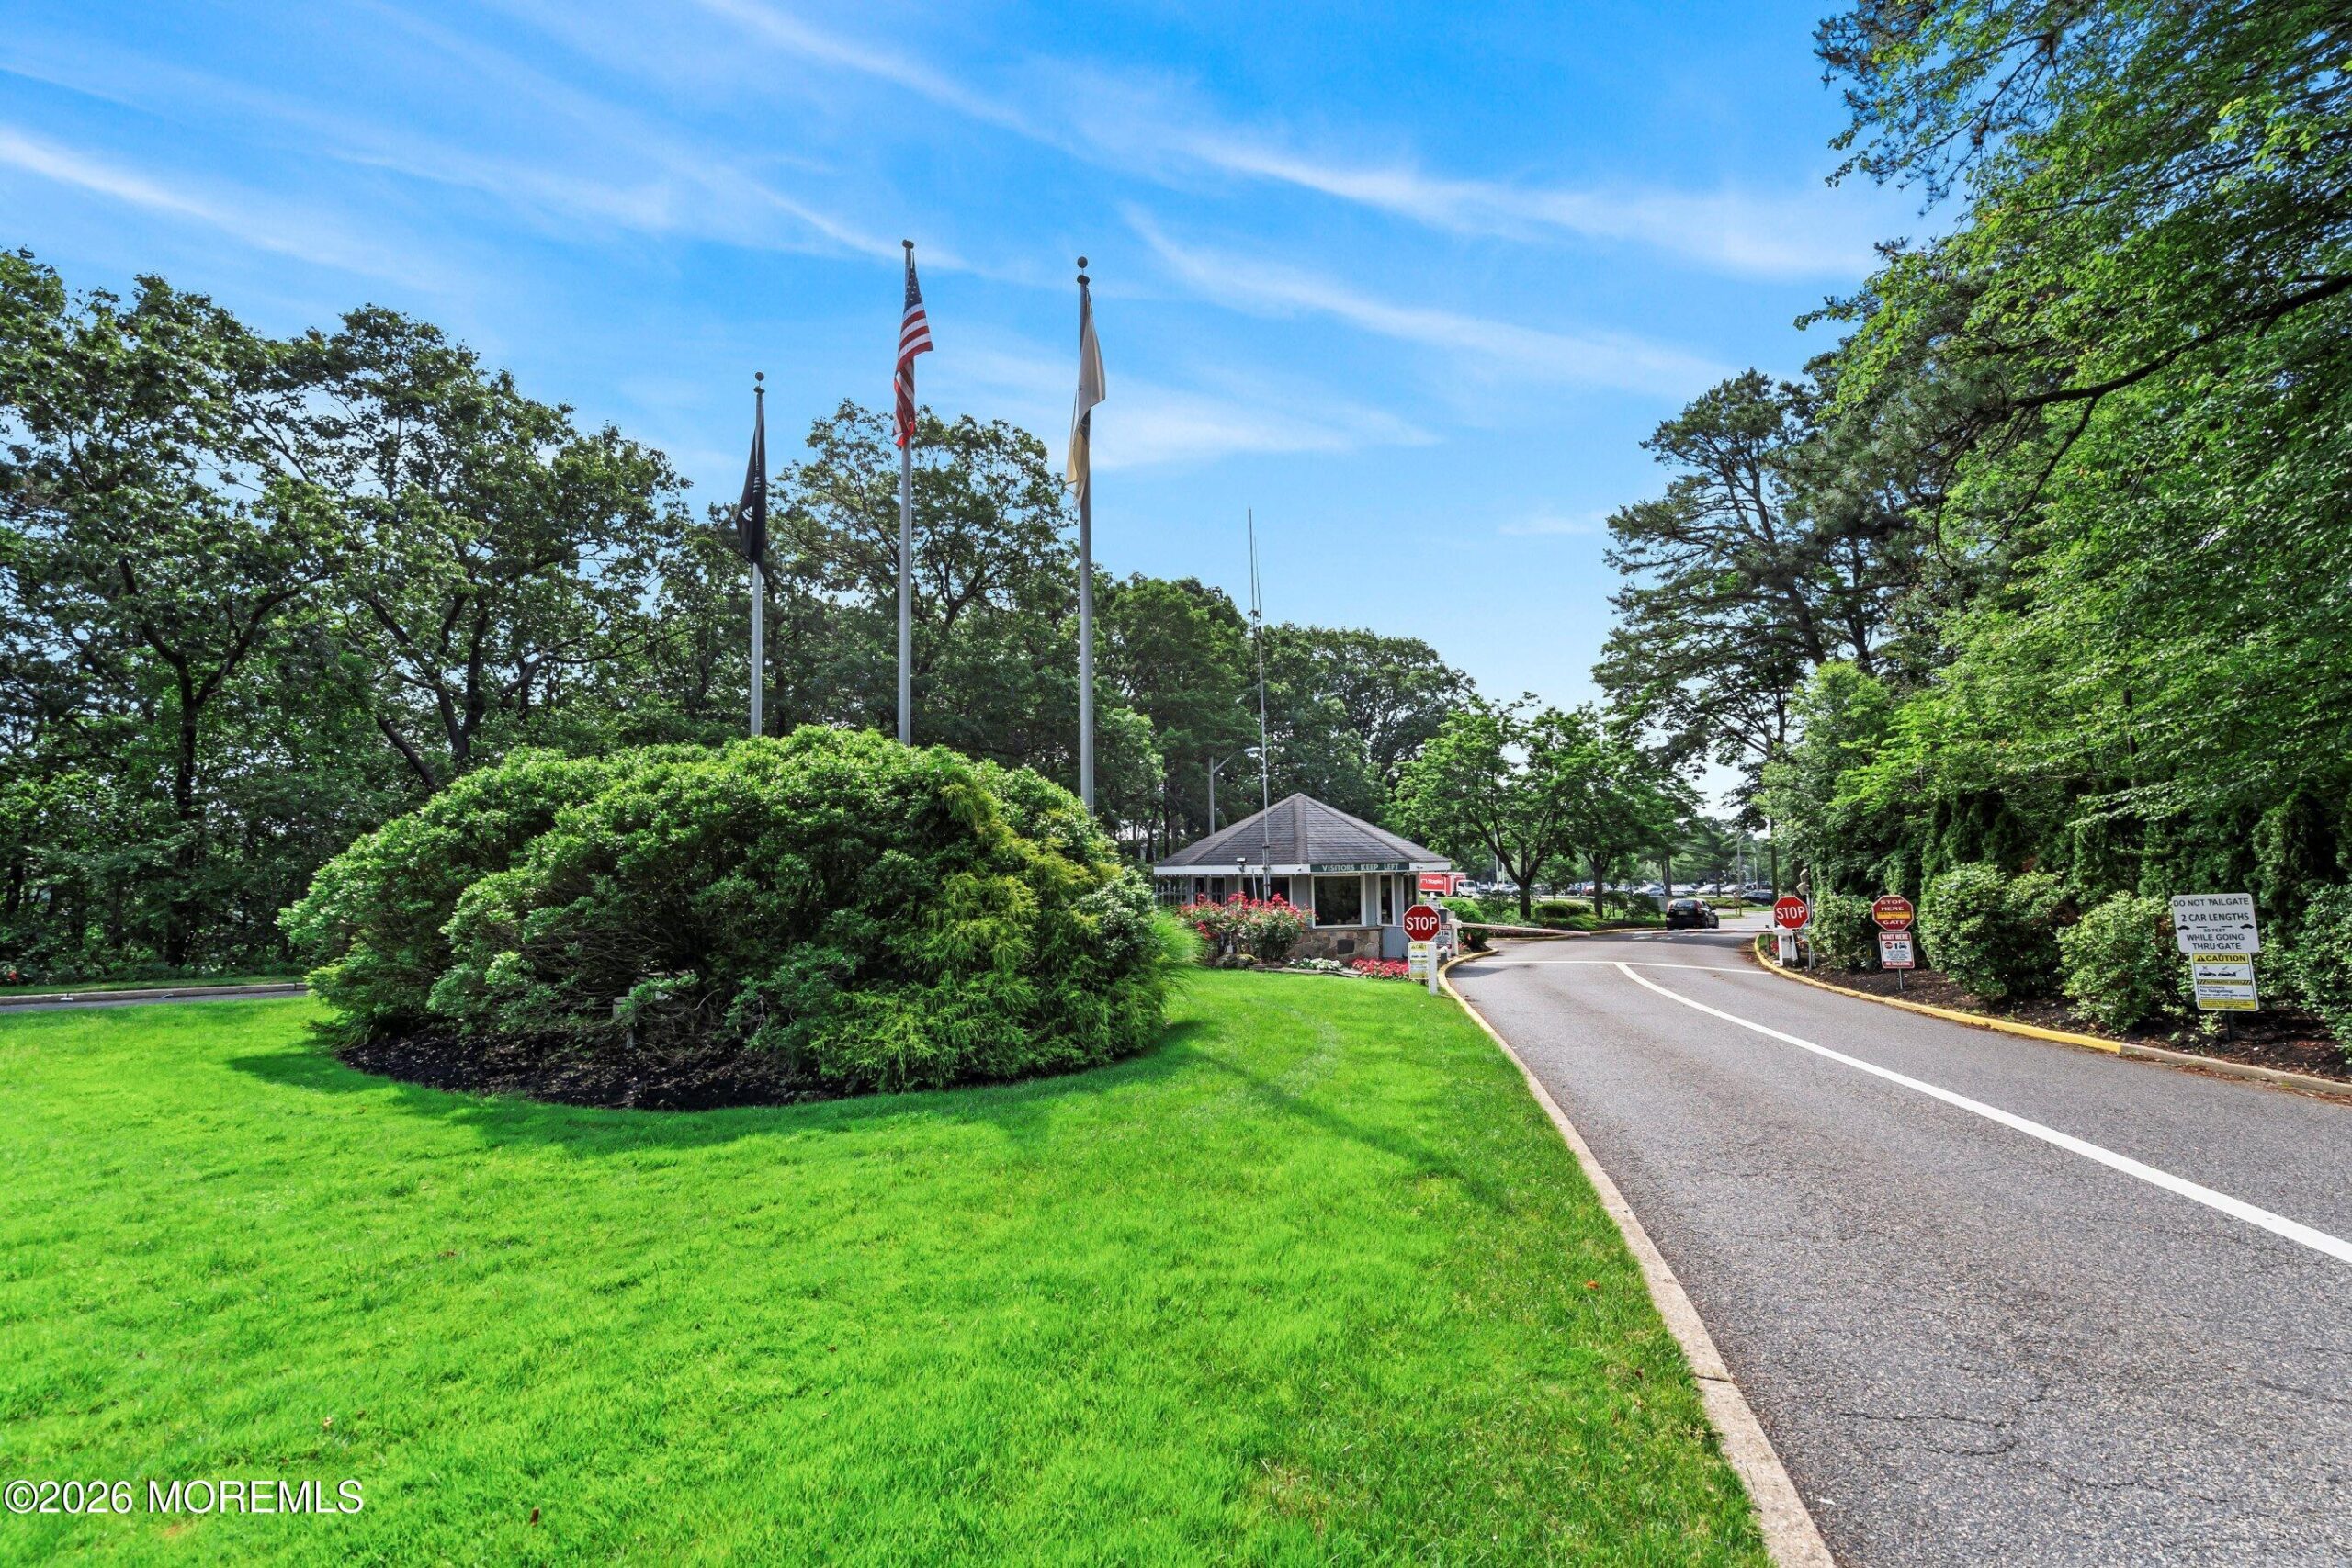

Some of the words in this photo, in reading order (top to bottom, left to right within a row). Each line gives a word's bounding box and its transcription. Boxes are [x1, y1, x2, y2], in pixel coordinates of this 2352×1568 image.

[2208, 897, 2250, 906] TAILGATE
[1776, 906, 1805, 919] STOP
[2181, 914, 2187, 922] 2
[2188, 913, 2207, 922] CAR
[2209, 912, 2249, 921] LENGTHS
[1406, 916, 1437, 931] STOP
